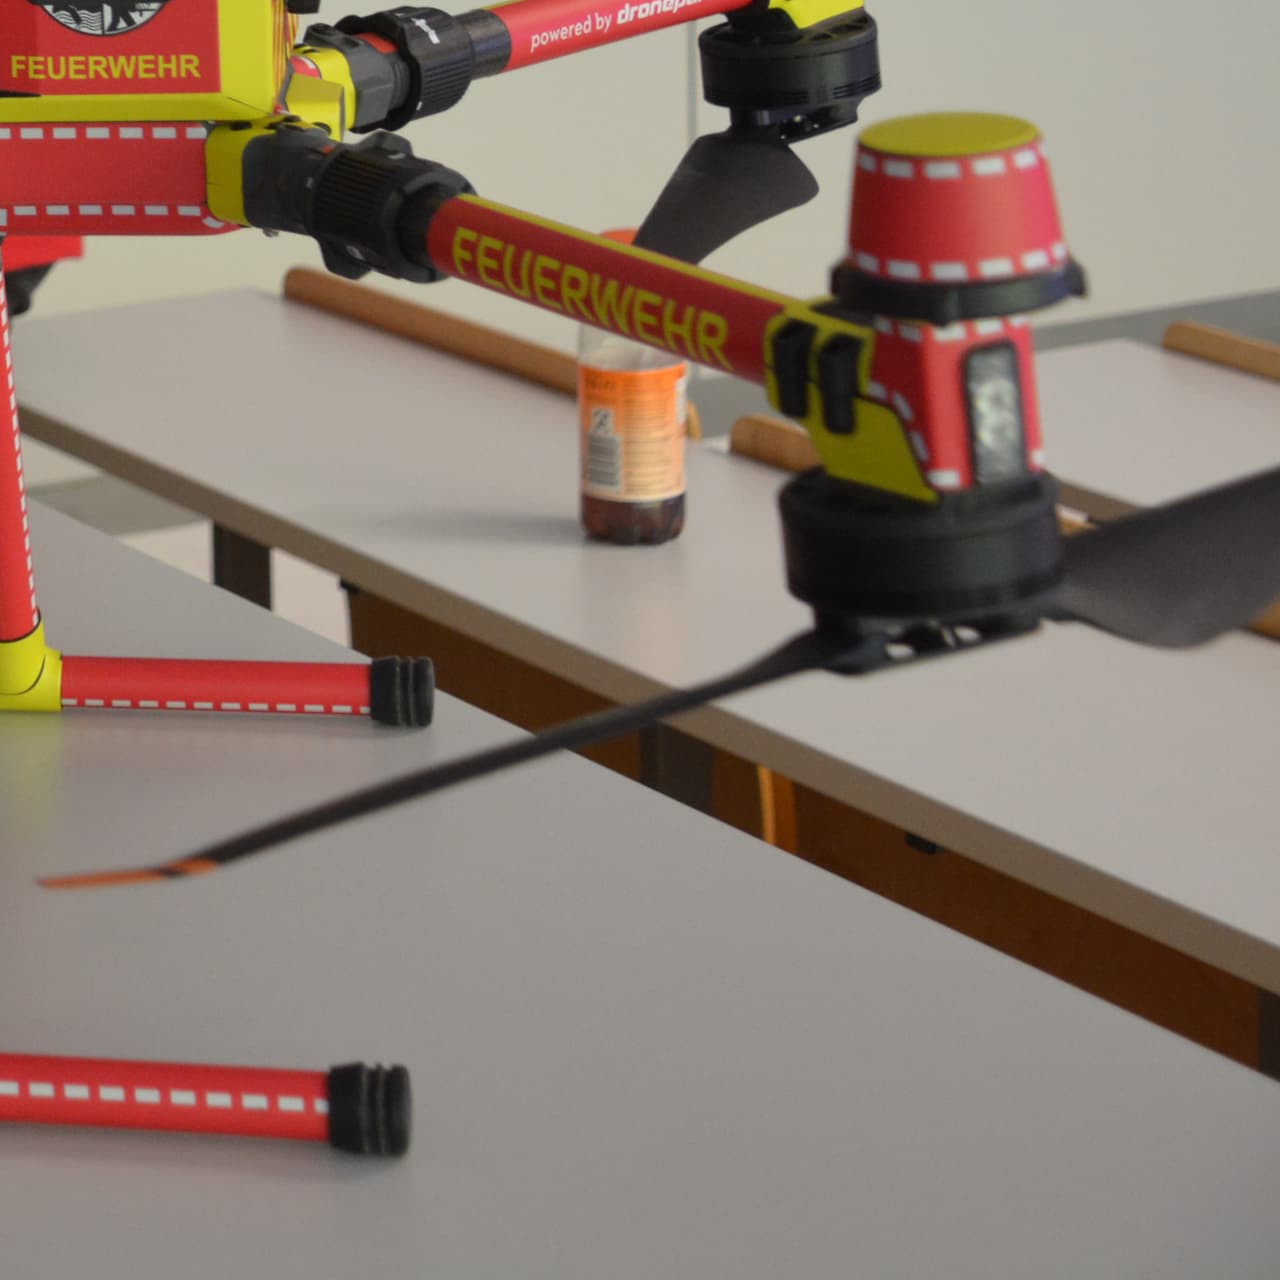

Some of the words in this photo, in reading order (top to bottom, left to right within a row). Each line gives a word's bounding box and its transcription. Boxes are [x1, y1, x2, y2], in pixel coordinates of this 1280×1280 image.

[530, 16, 592, 53] powered
[595, 12, 612, 33] by
[10, 54, 201, 80] FEUERWEHR
[451, 226, 735, 371] FEUERWEHR
